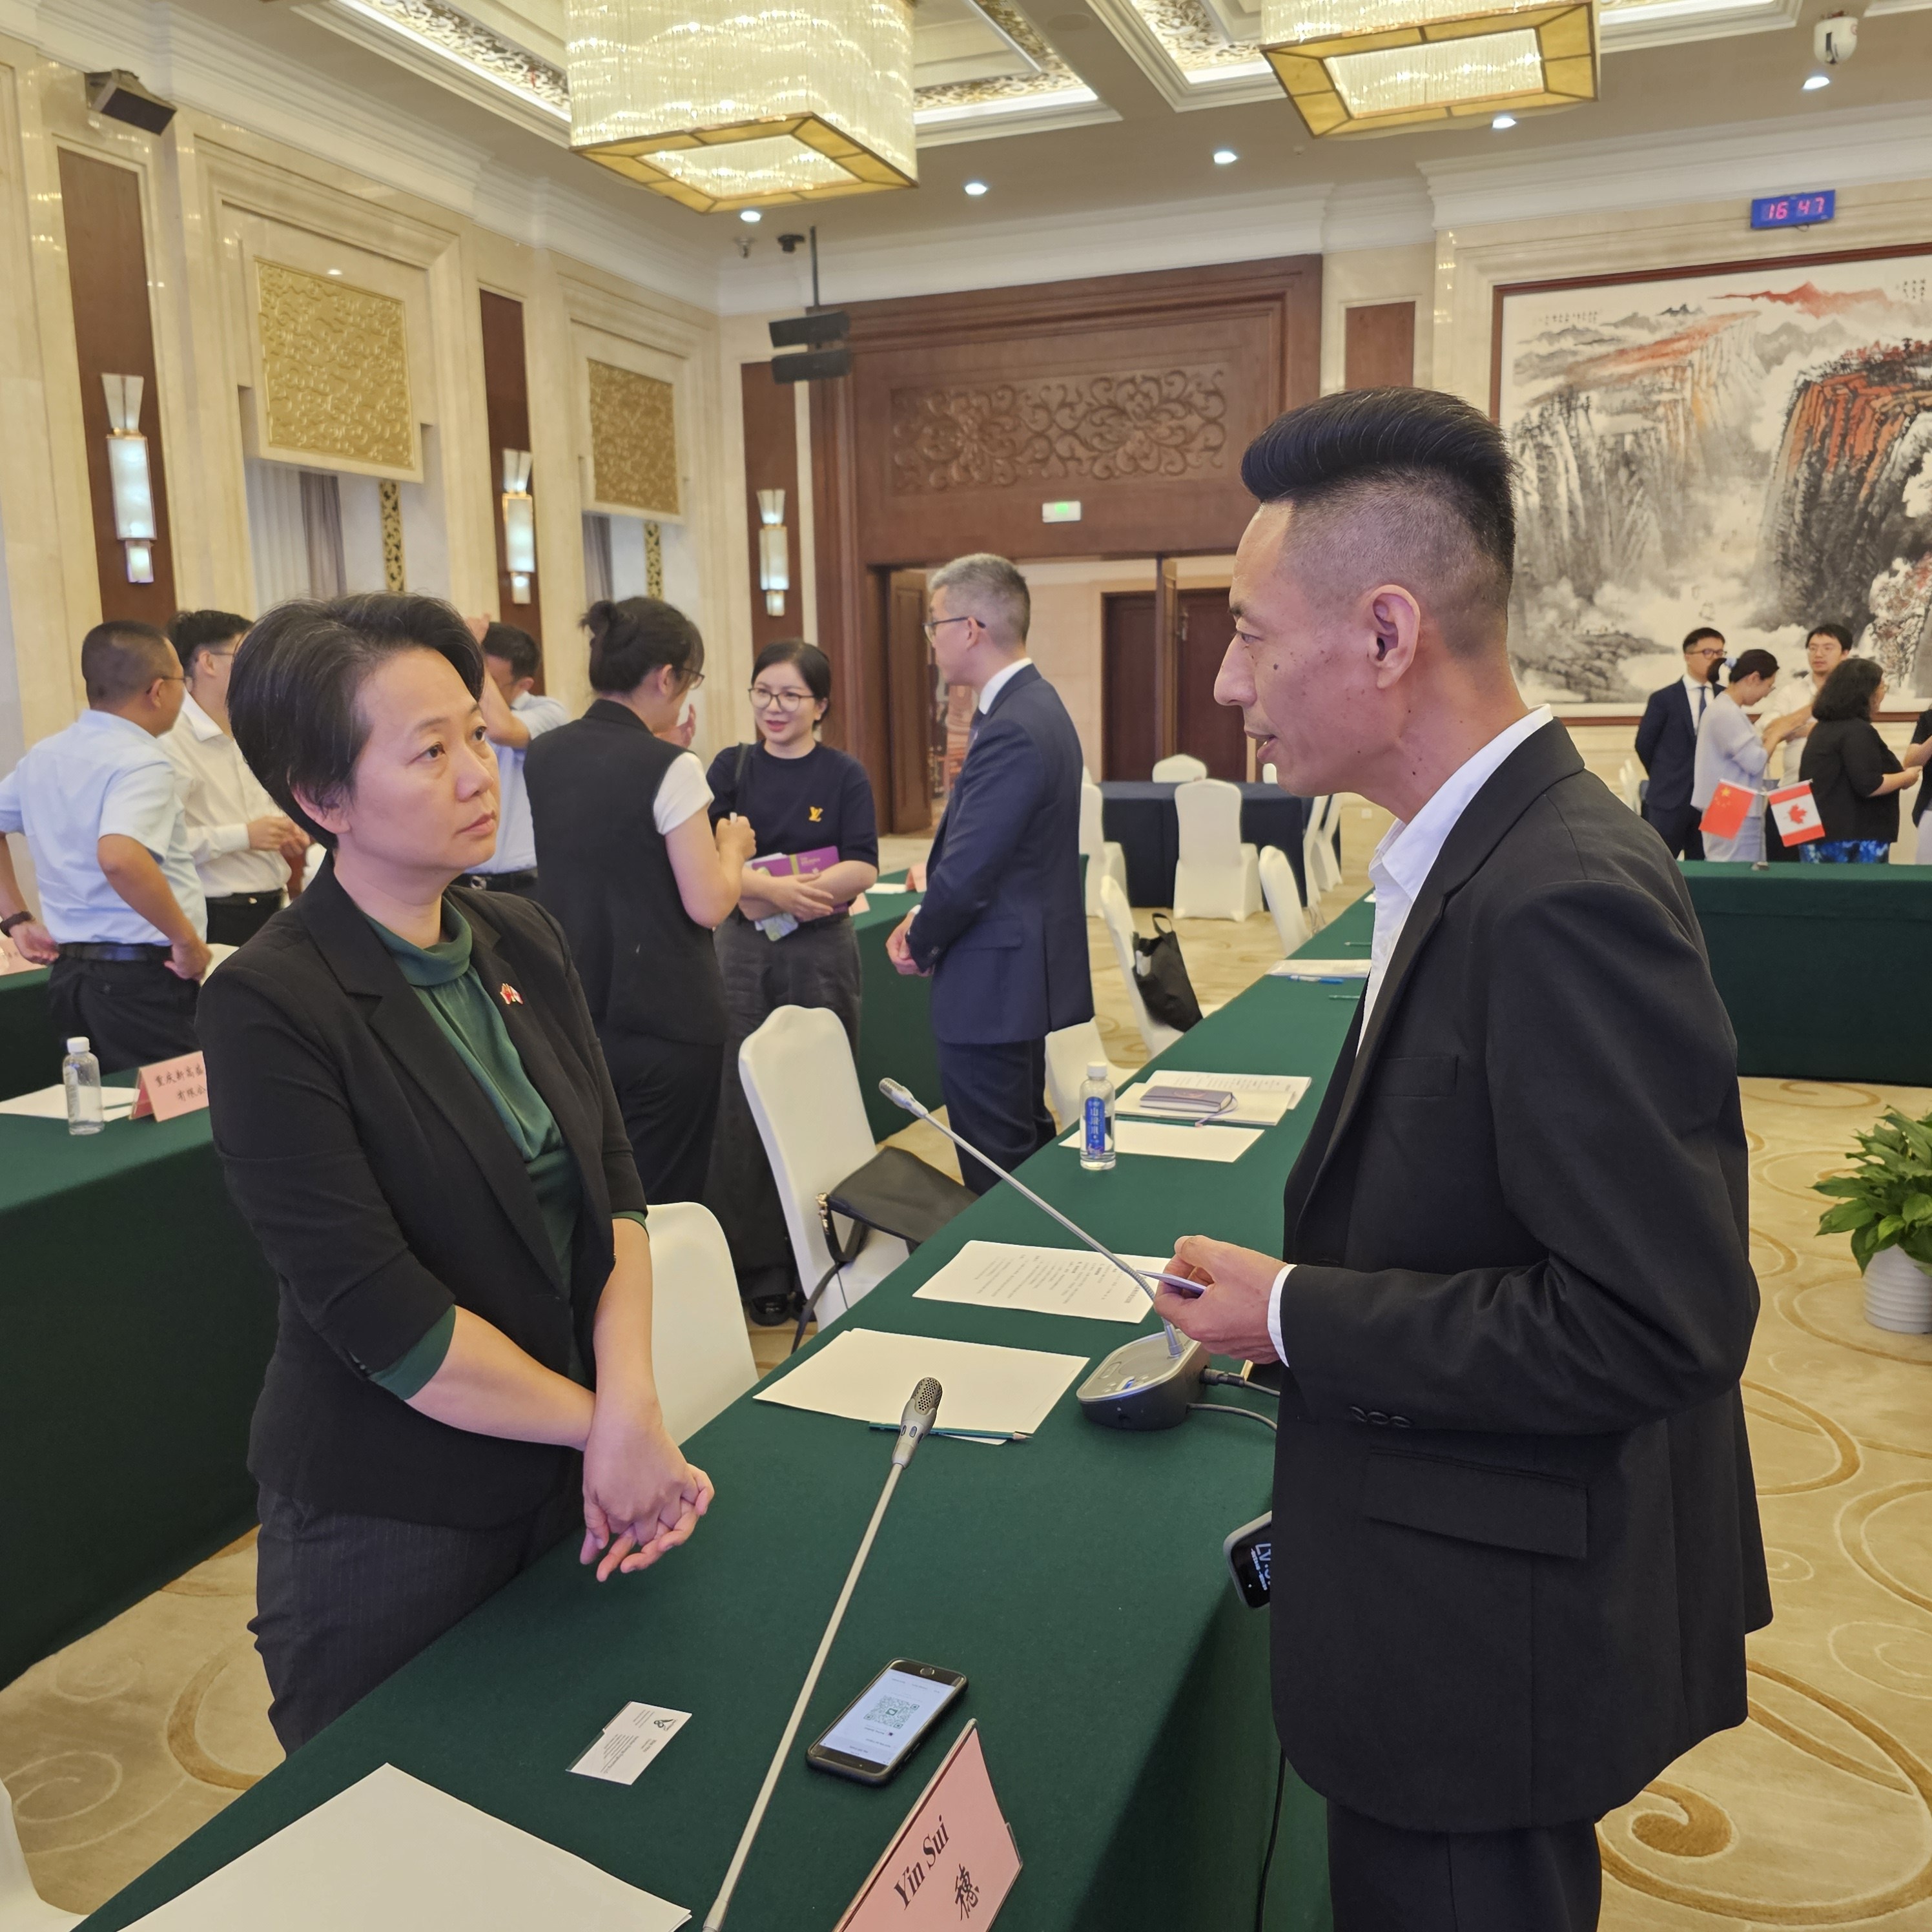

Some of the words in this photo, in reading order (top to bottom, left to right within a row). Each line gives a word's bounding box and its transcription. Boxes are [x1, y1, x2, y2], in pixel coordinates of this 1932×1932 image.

[1769, 201, 1789, 220] 16
[1798, 196, 1825, 215] 47
[894, 1862, 926, 1911] Yin
[923, 1814, 950, 1870] Sui
[955, 1863, 980, 1922] 穗
